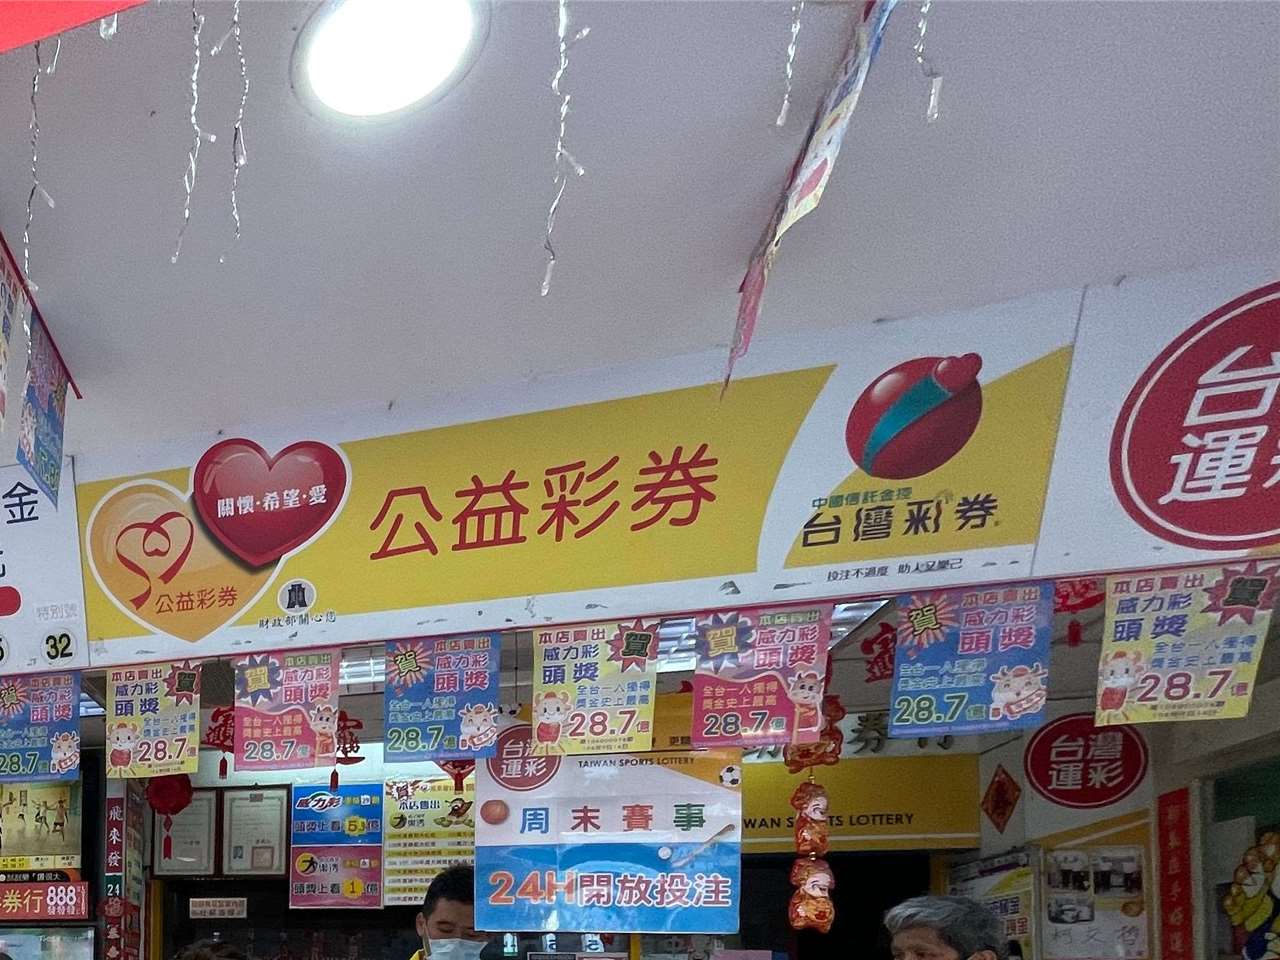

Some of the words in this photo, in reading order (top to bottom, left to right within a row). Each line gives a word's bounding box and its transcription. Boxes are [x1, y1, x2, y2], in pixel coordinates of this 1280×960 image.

[368, 442, 719, 562] 公益彩券
[801, 492, 996, 549] 台灣彩券
[1112, 574, 1205, 594] 本店賣出
[154, 584, 239, 616] 公益彩券
[1116, 592, 1193, 614] 威力彩
[907, 603, 941, 636] 賀
[963, 605, 1036, 627] 威力彩
[1112, 614, 1189, 643] 頭獎
[45, 632, 73, 660] 32
[539, 629, 606, 644] 本店賣出
[621, 632, 652, 658] 賀
[707, 626, 738, 658] 賀
[756, 625, 820, 646] 威力彩
[958, 624, 1036, 655] 頭獎
[394, 650, 422, 677] 賀
[543, 643, 600, 661] 威力彩
[754, 644, 817, 670] 頭獎
[542, 662, 599, 685] 頭獎
[1136, 669, 1233, 703] 28.7
[893, 693, 968, 725] 28.7
[569, 709, 637, 737] 28.7
[703, 710, 769, 737] 28.7
[138, 737, 187, 763] 28.7
[244, 740, 296, 762] 28.7
[386, 725, 444, 752] 28.7
[1049, 731, 1126, 763] 台灣
[500, 756, 547, 779] 運彩
[578, 759, 617, 769] TAIWAN
[619, 758, 655, 768] SPORTS
[656, 756, 695, 767] LOTTERY
[1047, 762, 1126, 791] 運彩
[519, 803, 706, 835] 周末賽事
[743, 816, 782, 829] WAN
[849, 813, 915, 826] LOTTERY
[108, 804, 123, 868] 飛來發
[46, 885, 77, 906] 888
[106, 883, 121, 898] 24
